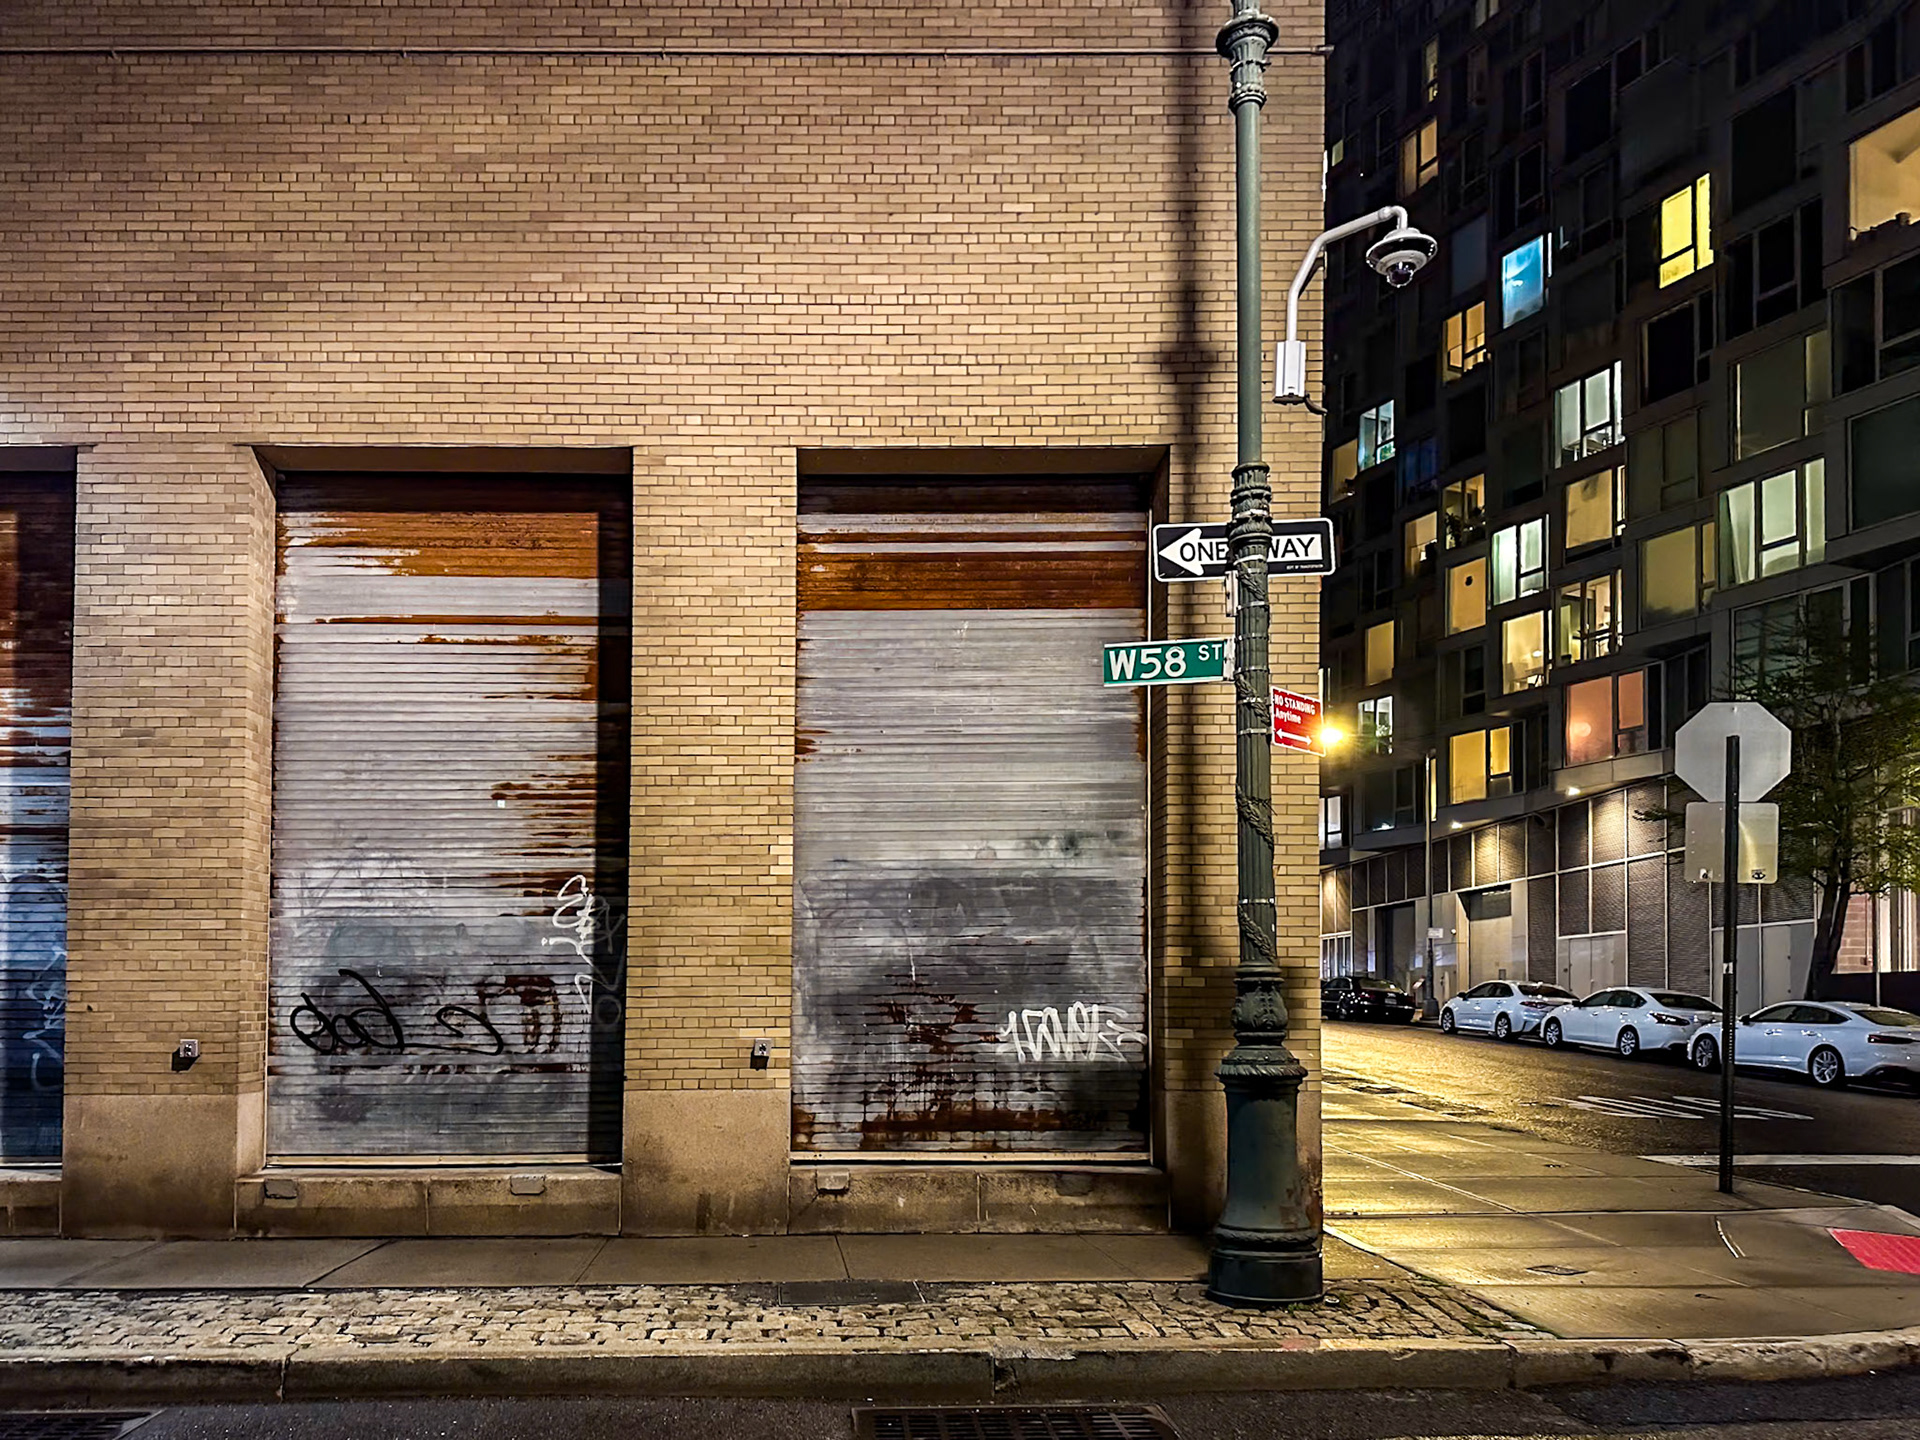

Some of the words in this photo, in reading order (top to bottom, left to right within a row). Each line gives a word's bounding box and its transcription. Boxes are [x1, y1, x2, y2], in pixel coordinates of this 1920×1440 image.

[1180, 541, 1228, 562] ONE
[1198, 644, 1222, 661] ST
[1274, 693, 1284, 706] NO
[1284, 697, 1316, 715] STANDING
[1275, 707, 1302, 724] Anytime
